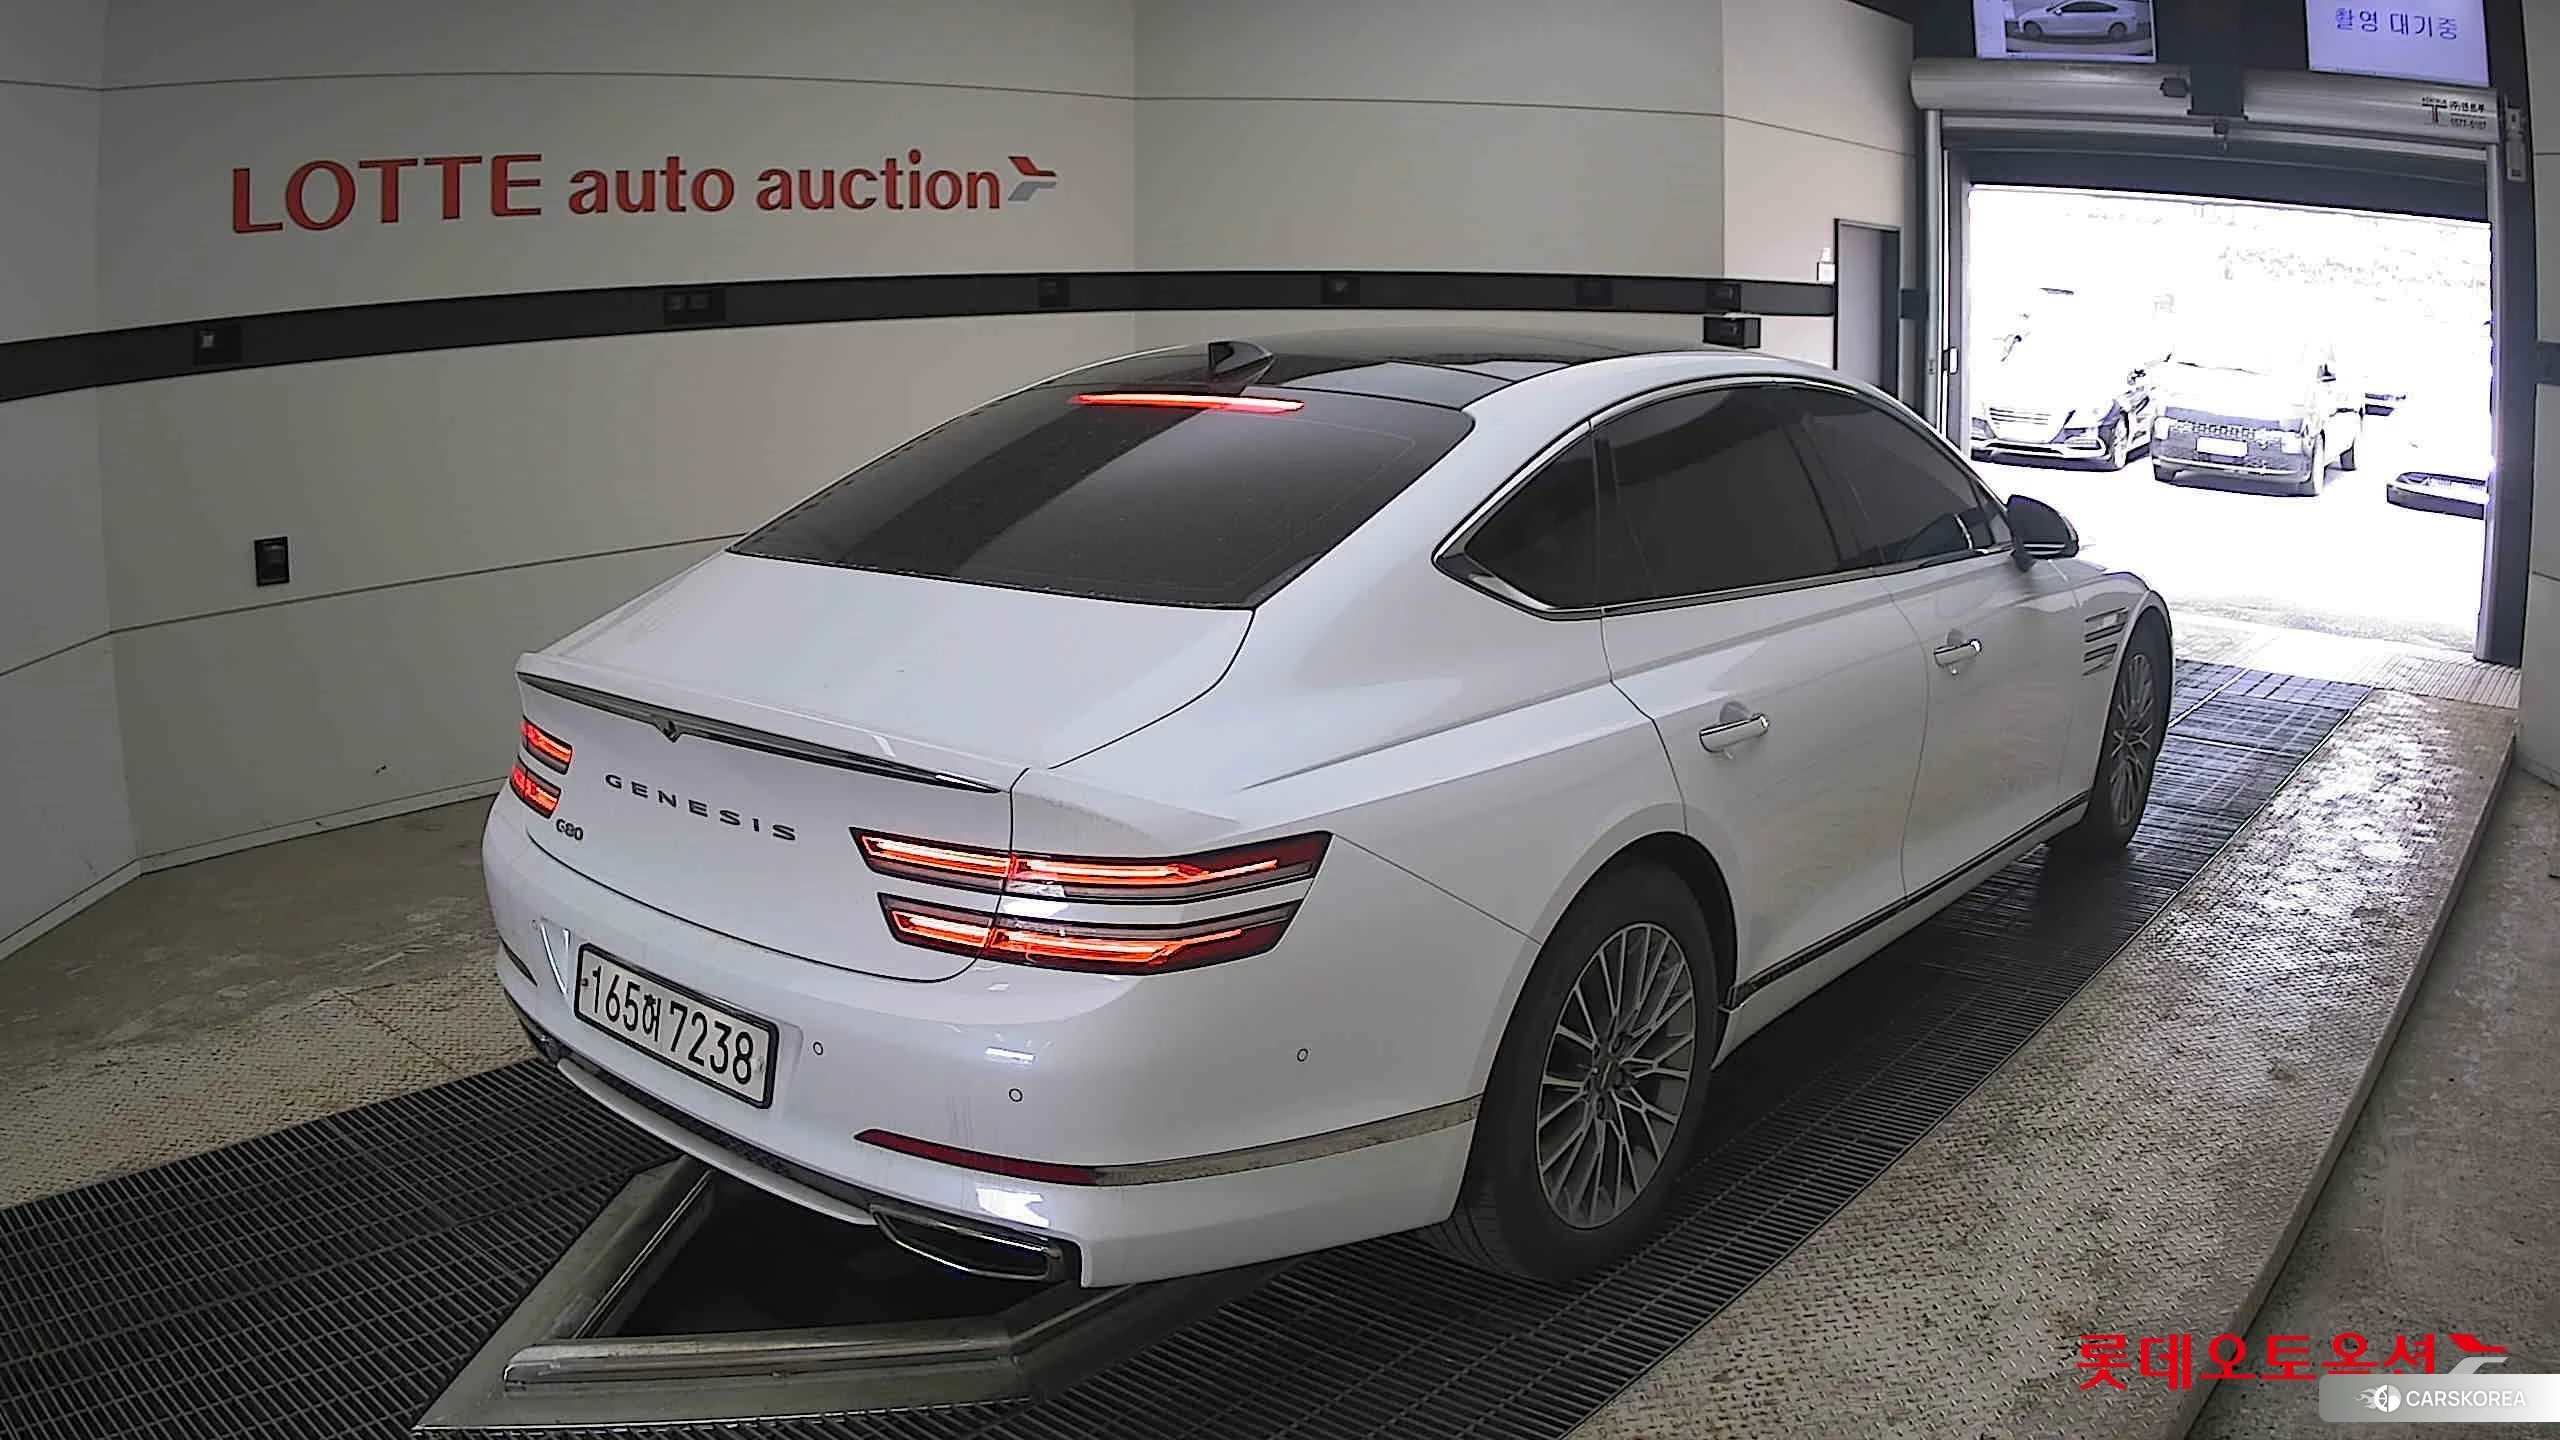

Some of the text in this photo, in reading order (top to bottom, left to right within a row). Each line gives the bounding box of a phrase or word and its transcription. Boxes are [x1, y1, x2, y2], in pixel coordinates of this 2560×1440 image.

[232, 148, 1001, 234] LOTTE auto auction
[555, 818, 585, 841] G80
[605, 774, 796, 841] GENESIS
[592, 964, 754, 1085] 165허 7238
